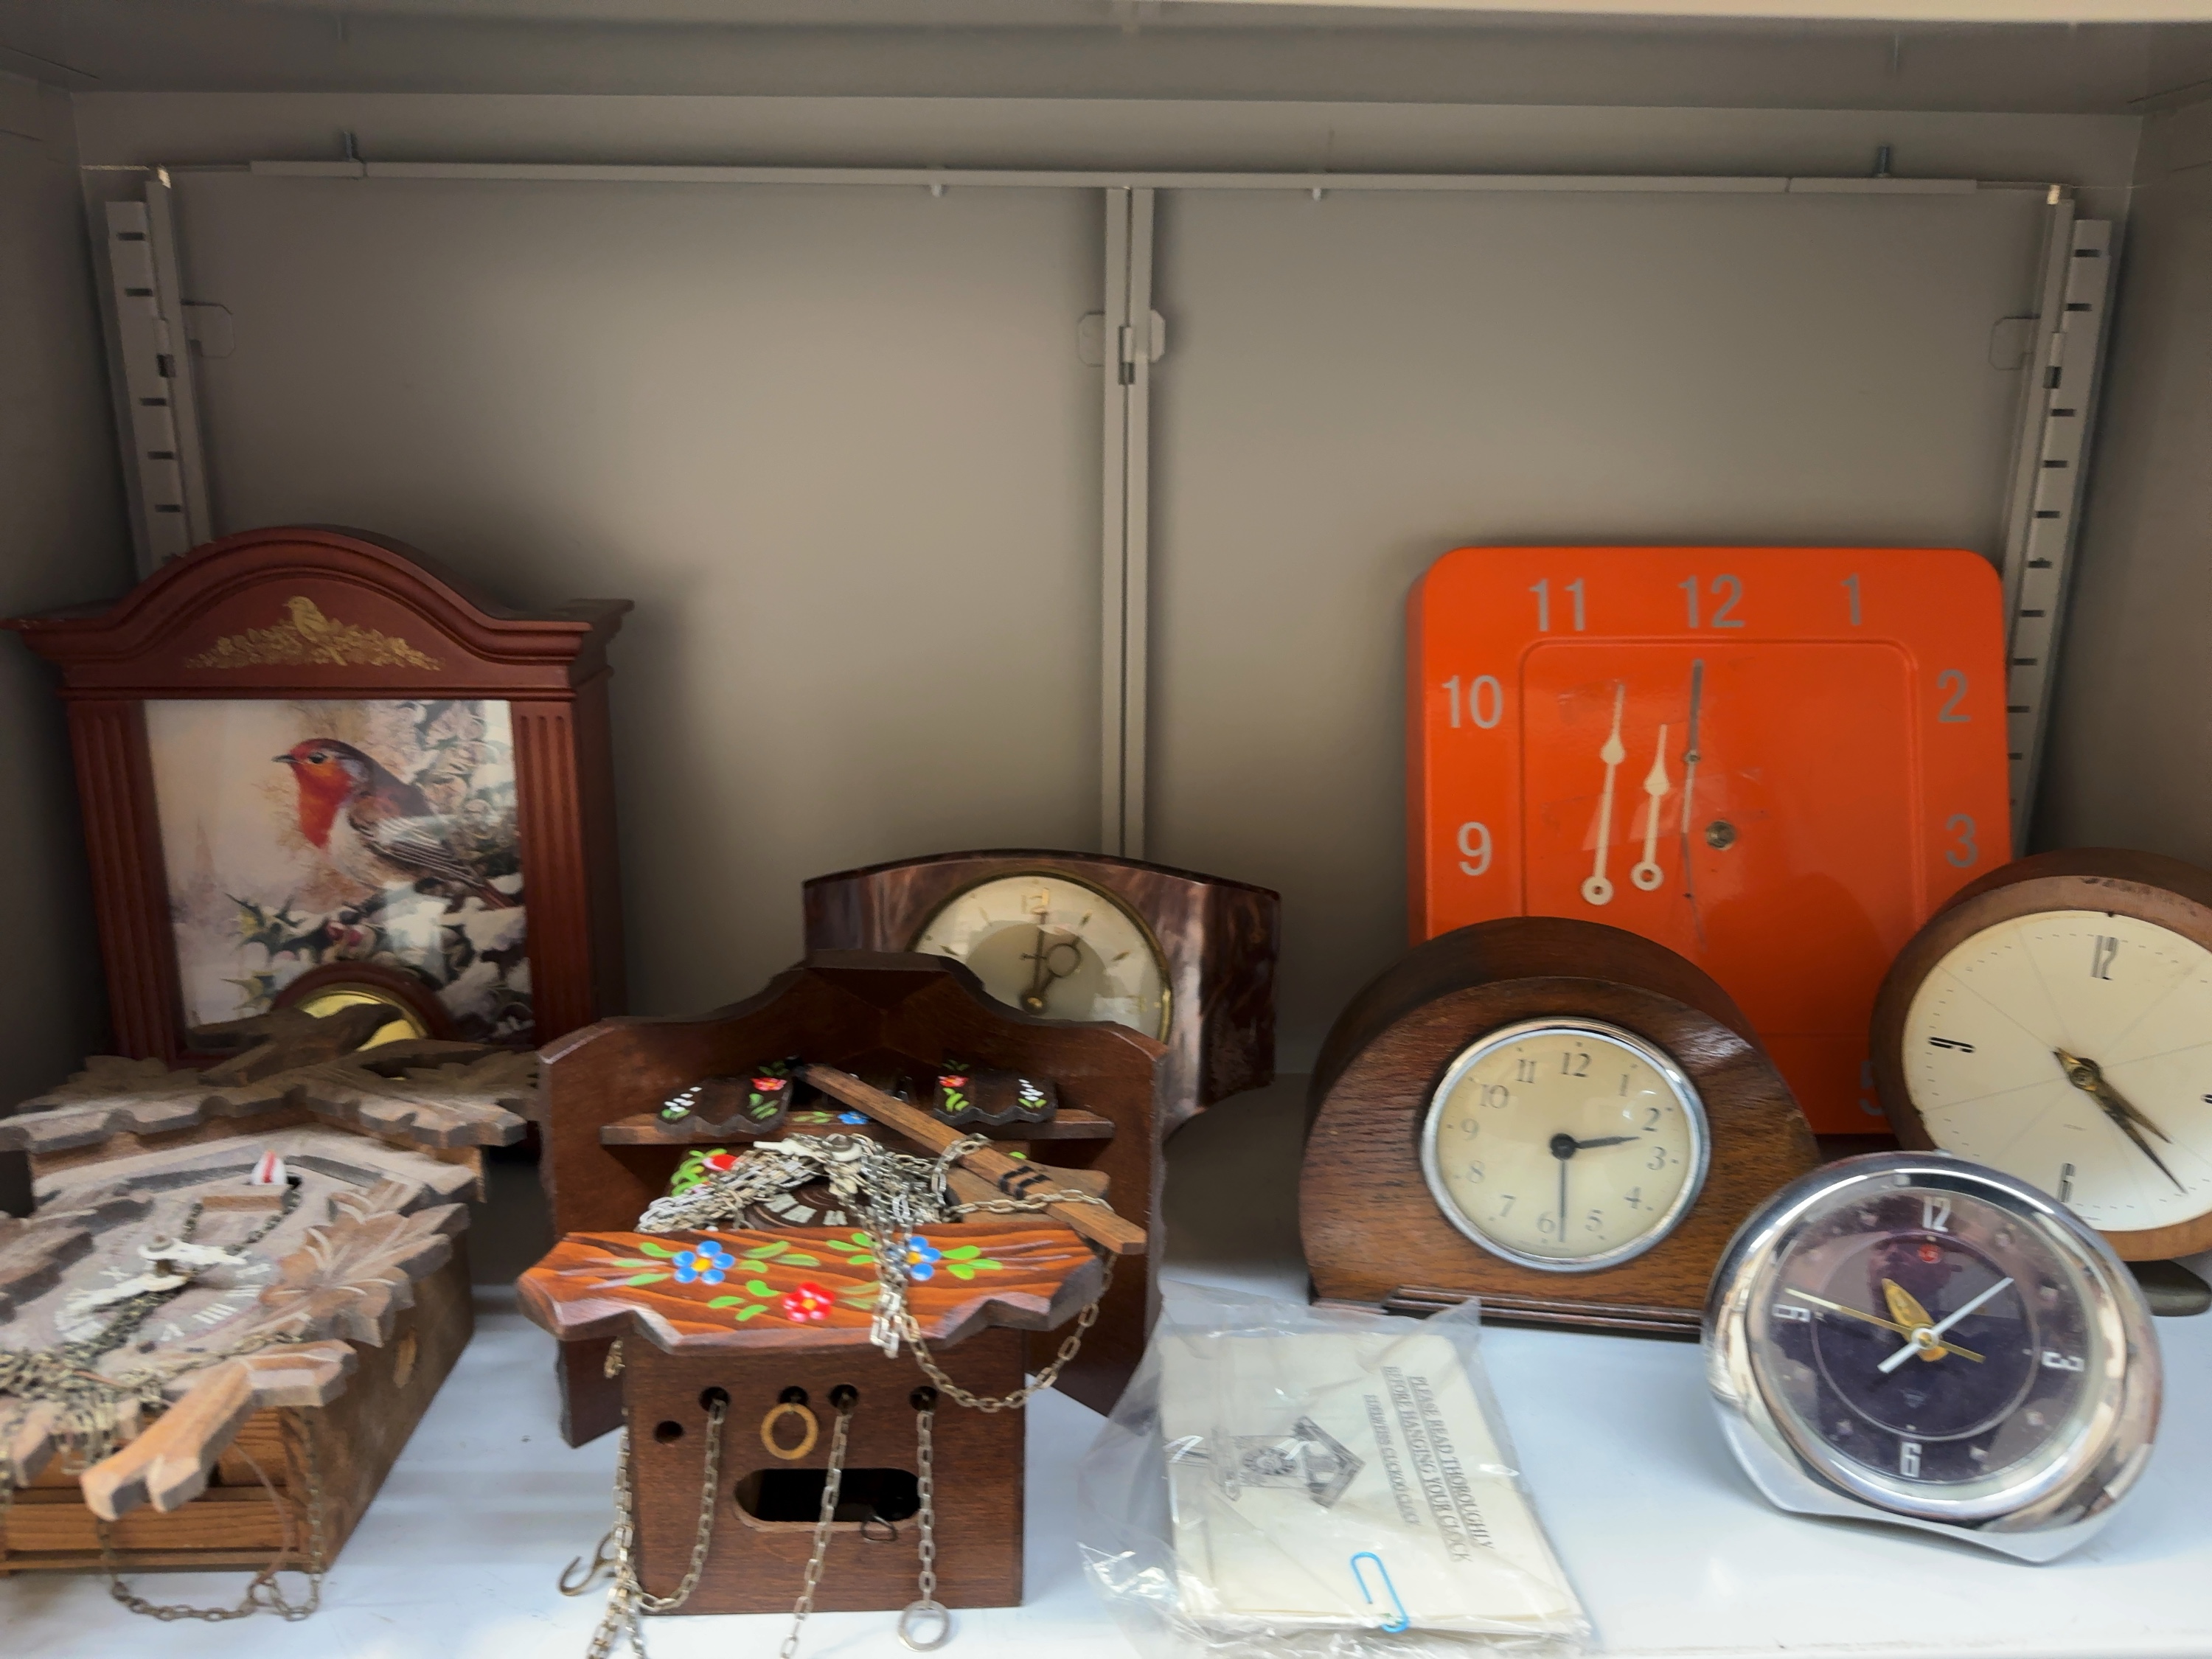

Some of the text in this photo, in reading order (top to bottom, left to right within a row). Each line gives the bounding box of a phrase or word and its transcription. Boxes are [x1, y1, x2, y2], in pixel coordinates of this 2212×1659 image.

[1528, 578, 1586, 631] 11
[1677, 574, 1746, 628] 12
[1840, 574, 1862, 626] 1
[1441, 675, 1503, 729] 10
[1935, 669, 1972, 723] 2
[1457, 821, 1494, 876] 9
[1944, 813, 1978, 868] 3
[2090, 934, 2119, 981] 12
[1515, 1058, 1537, 1083] 11
[1559, 1052, 1592, 1077] 12
[1479, 1083, 1509, 1108] 10
[1618, 1074, 1630, 1096] 1
[1461, 1118, 1479, 1141] 9
[1641, 1107, 1661, 1132] 2
[1465, 1160, 1486, 1183] 8
[1646, 1146, 1667, 1170] 3
[1500, 1194, 1516, 1217] 7
[1624, 1186, 1642, 1210] 4
[1537, 1211, 1556, 1234] 6
[1585, 1208, 1604, 1232] 5
[1921, 1195, 1951, 1233] 12
[1399, 1410, 1439, 1473] HANGING
[1423, 1476, 1453, 1511] YOUR
[1407, 1376, 1496, 1549] PLEASE READ THOROUGHLY
[1900, 1441, 1923, 1477] 6
